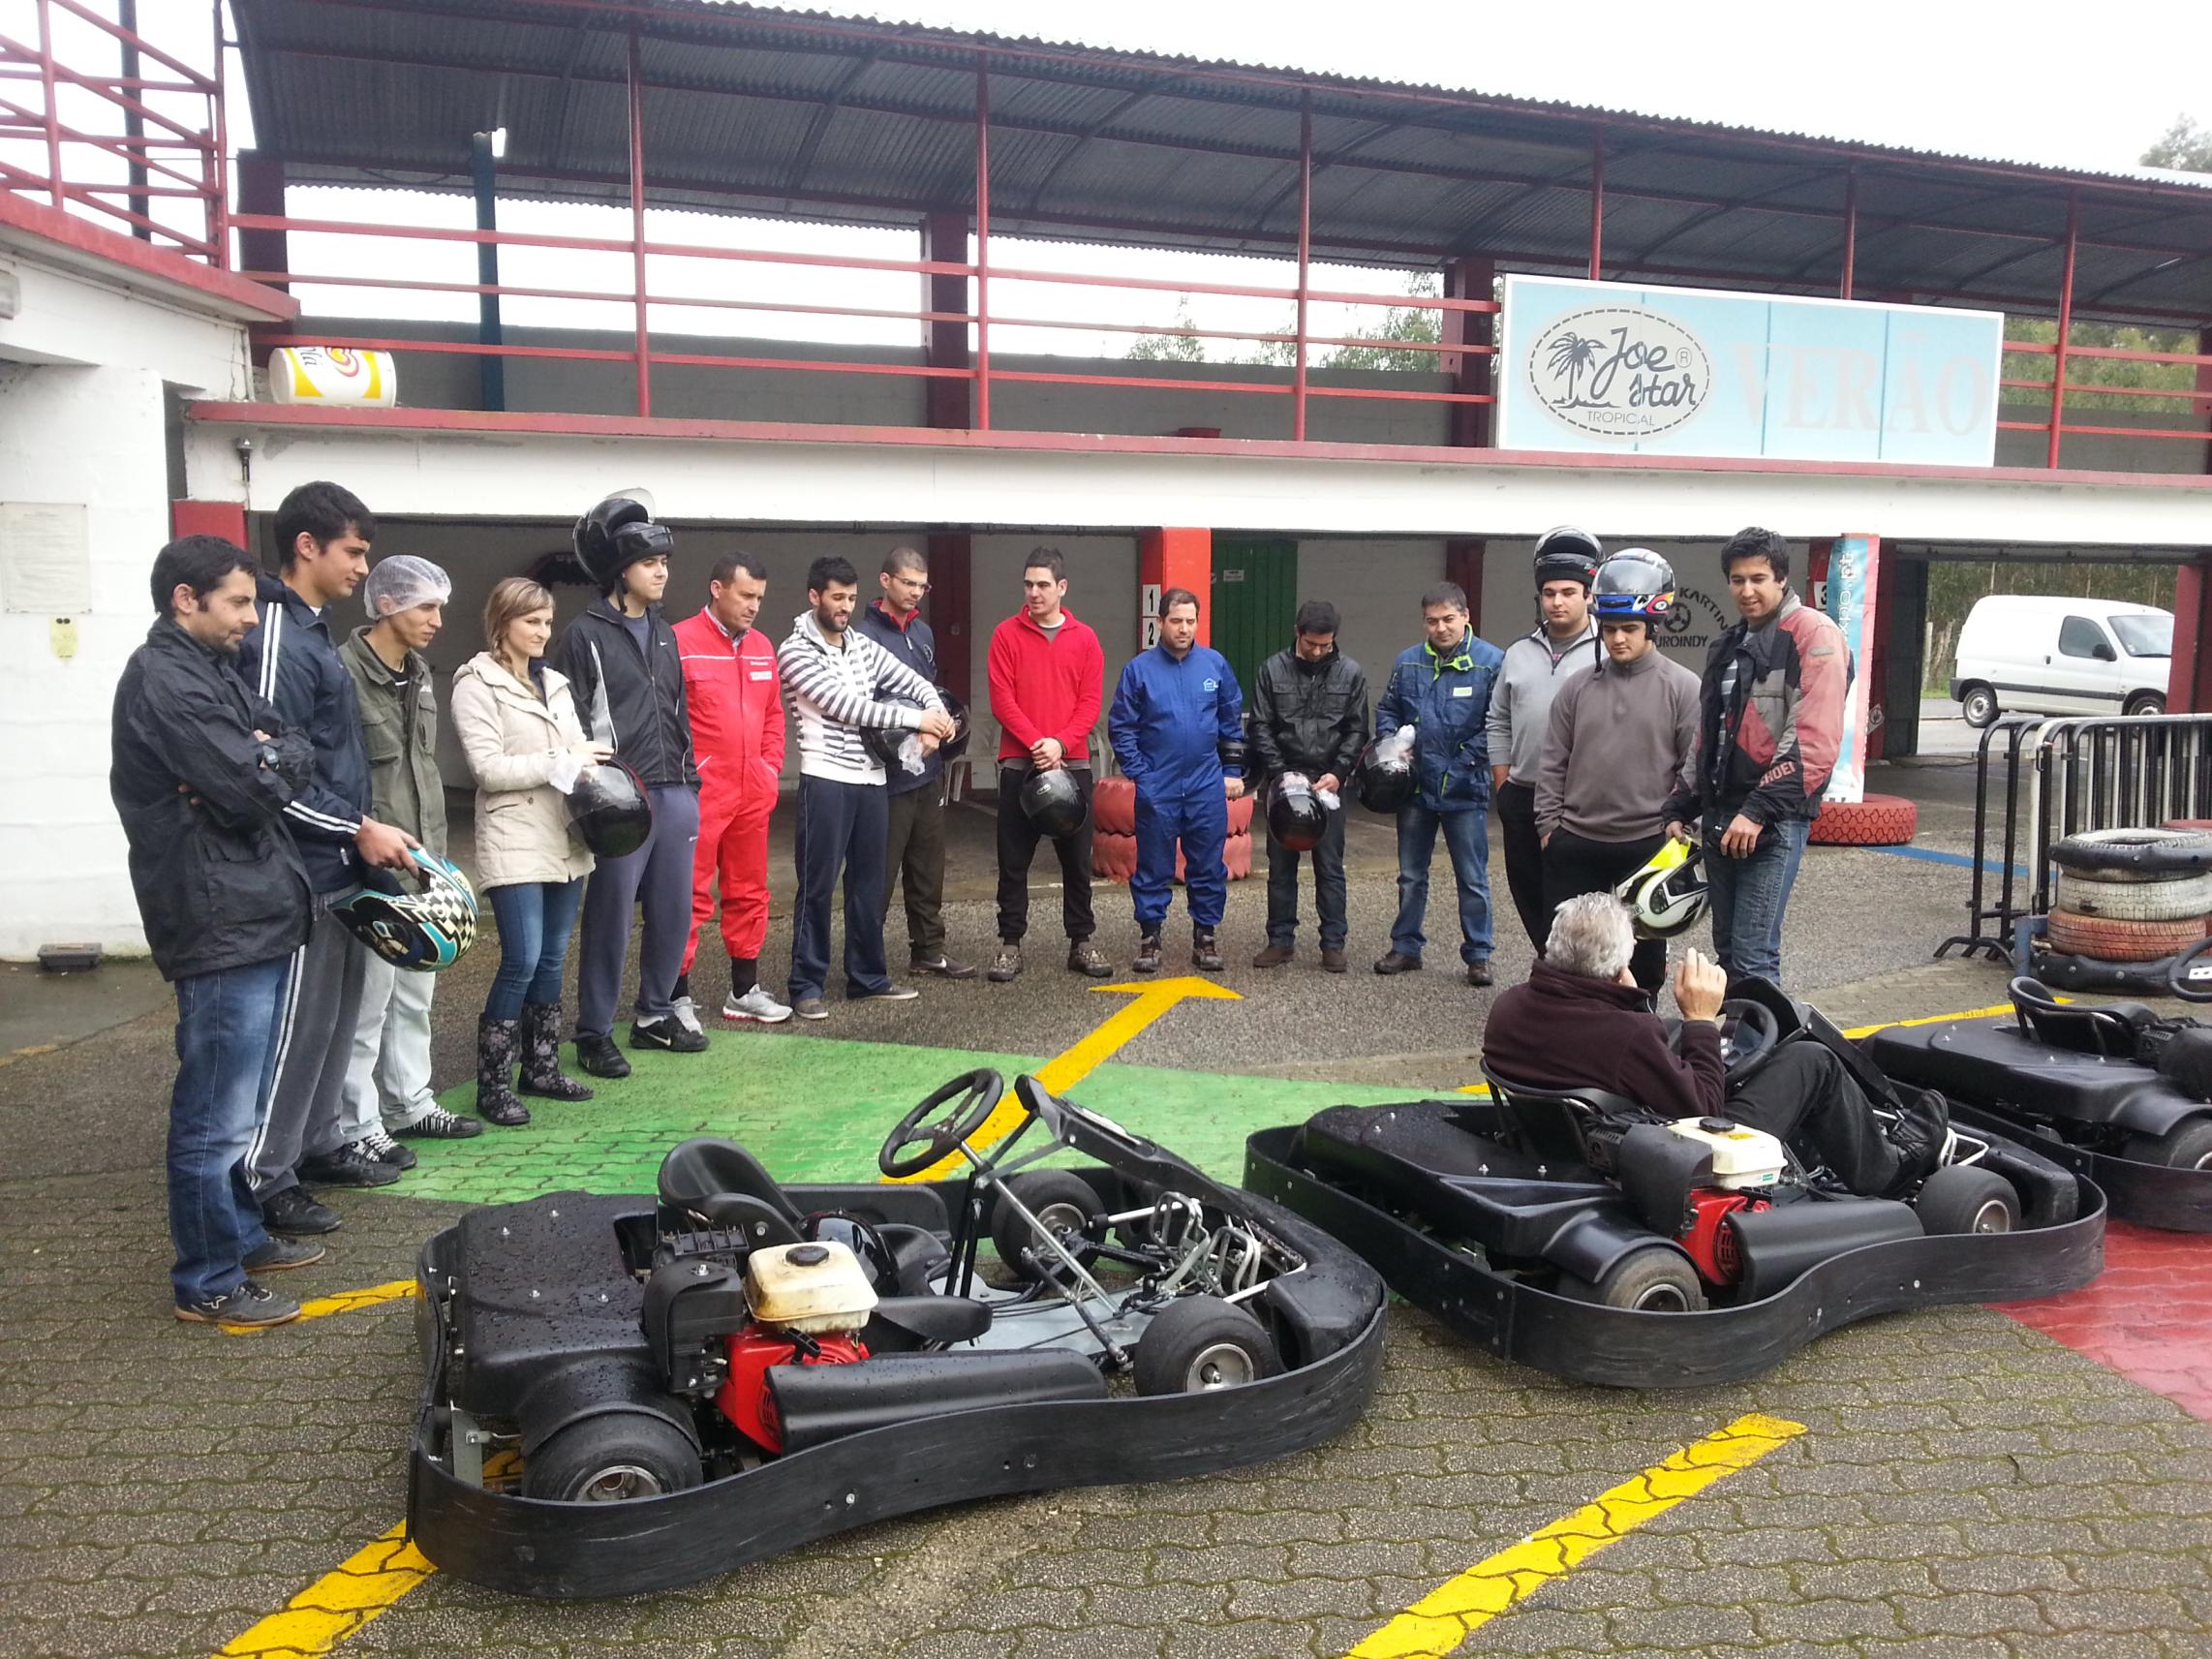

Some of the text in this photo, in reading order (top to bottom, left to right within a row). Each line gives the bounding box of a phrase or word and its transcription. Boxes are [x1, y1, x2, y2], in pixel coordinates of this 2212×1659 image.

[1589, 326, 1675, 401] Joe
[1728, 330, 1987, 437] VERÃO
[1587, 410, 1655, 427] TROPICAL
[1678, 587, 1729, 630] KARTIN
[1148, 621, 1154, 646] 2
[1655, 634, 1708, 648] UROINDY
